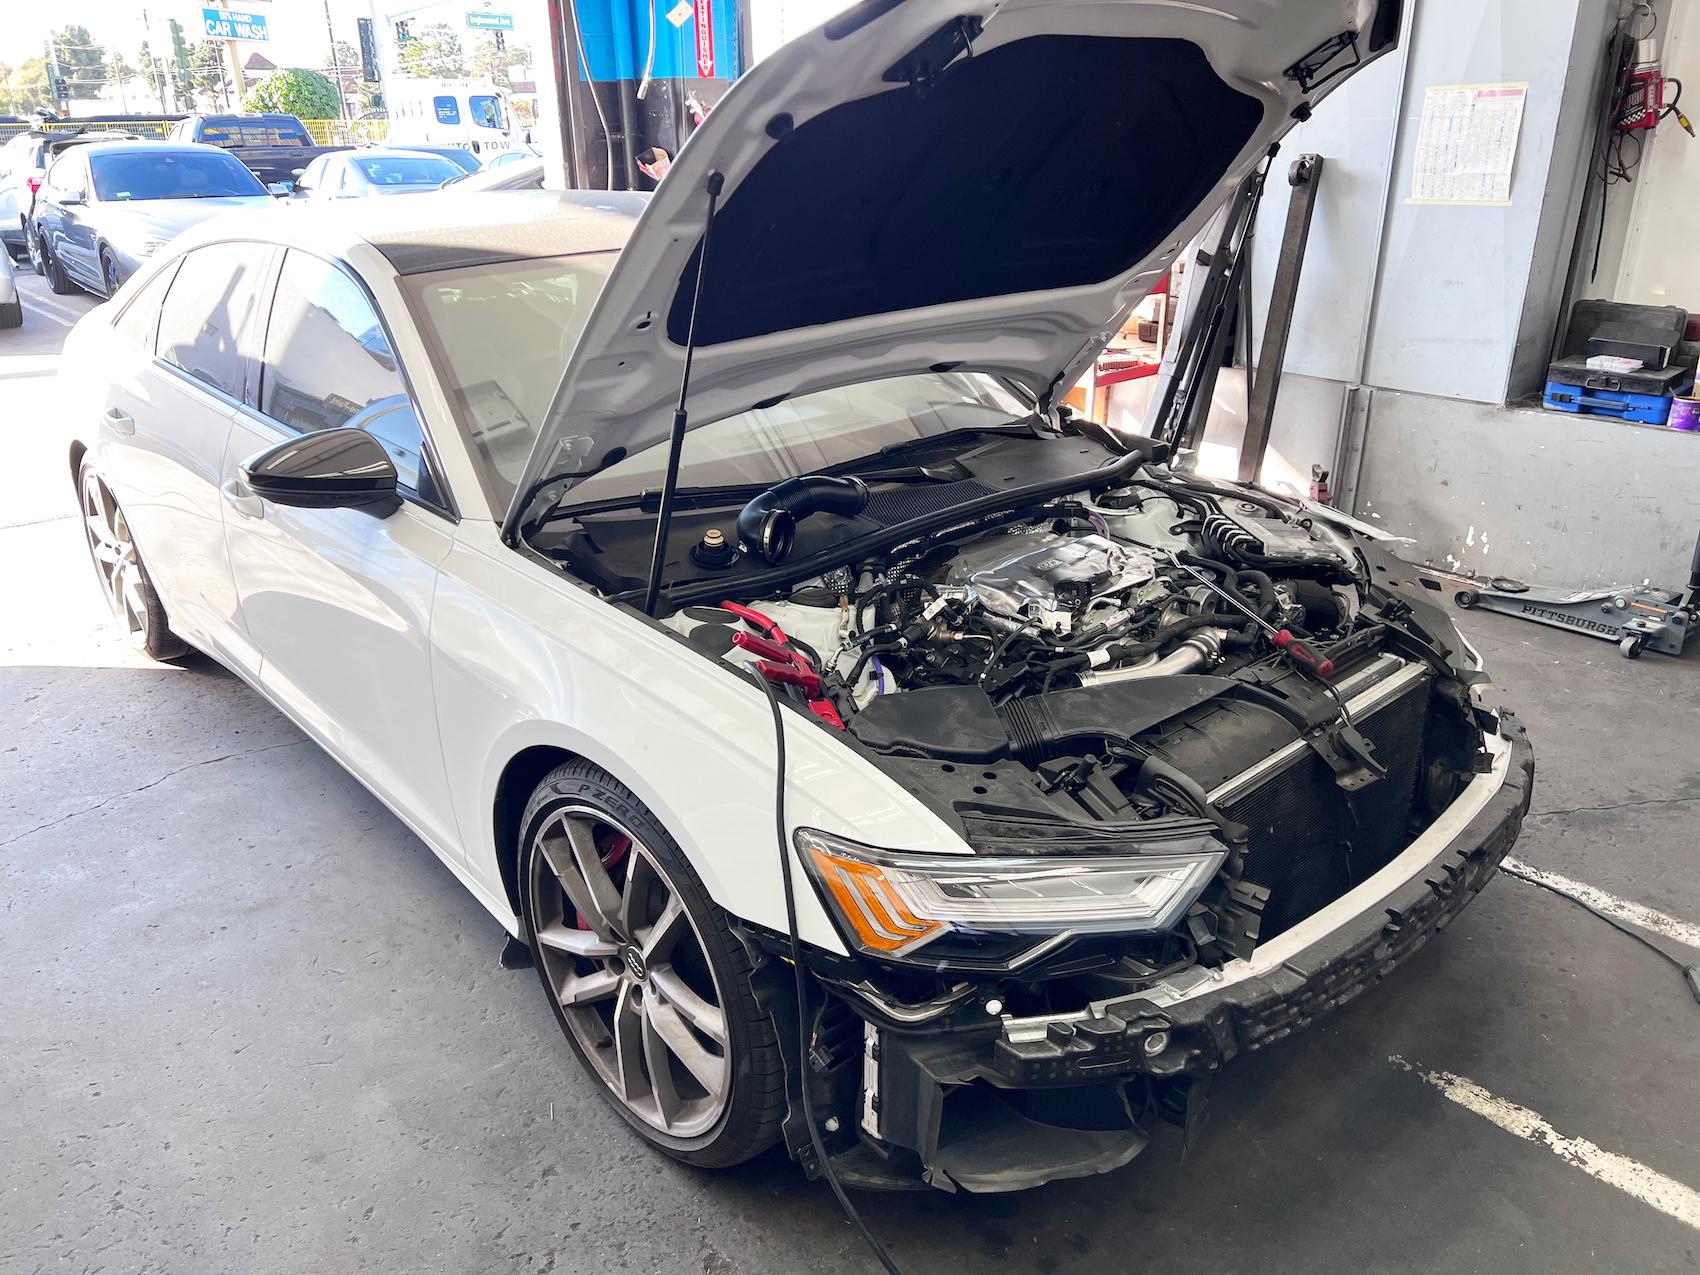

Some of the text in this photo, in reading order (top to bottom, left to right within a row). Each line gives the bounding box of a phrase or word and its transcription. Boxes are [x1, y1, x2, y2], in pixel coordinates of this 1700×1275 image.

[205, 19, 267, 40] CAR WASH
[484, 142, 510, 150] TOW
[1521, 605, 1619, 635] PITTSBURGH
[578, 784, 645, 828] P ZERO
